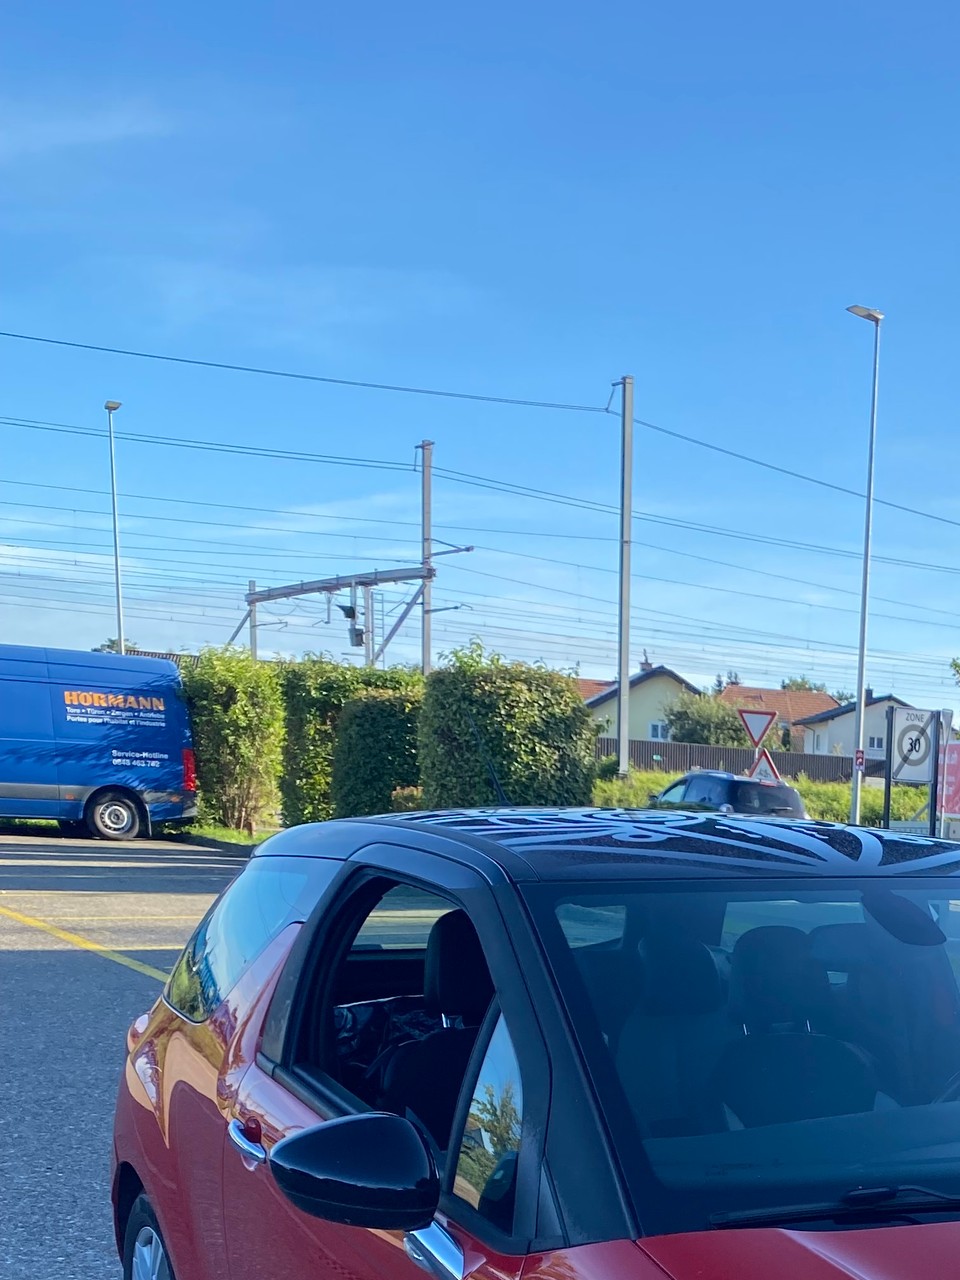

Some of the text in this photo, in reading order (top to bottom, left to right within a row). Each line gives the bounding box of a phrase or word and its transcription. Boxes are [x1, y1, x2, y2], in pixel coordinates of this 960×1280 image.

[64, 691, 165, 711] HÖRMANN
[905, 712, 924, 723] ZONE
[907, 737, 921, 753] 30
